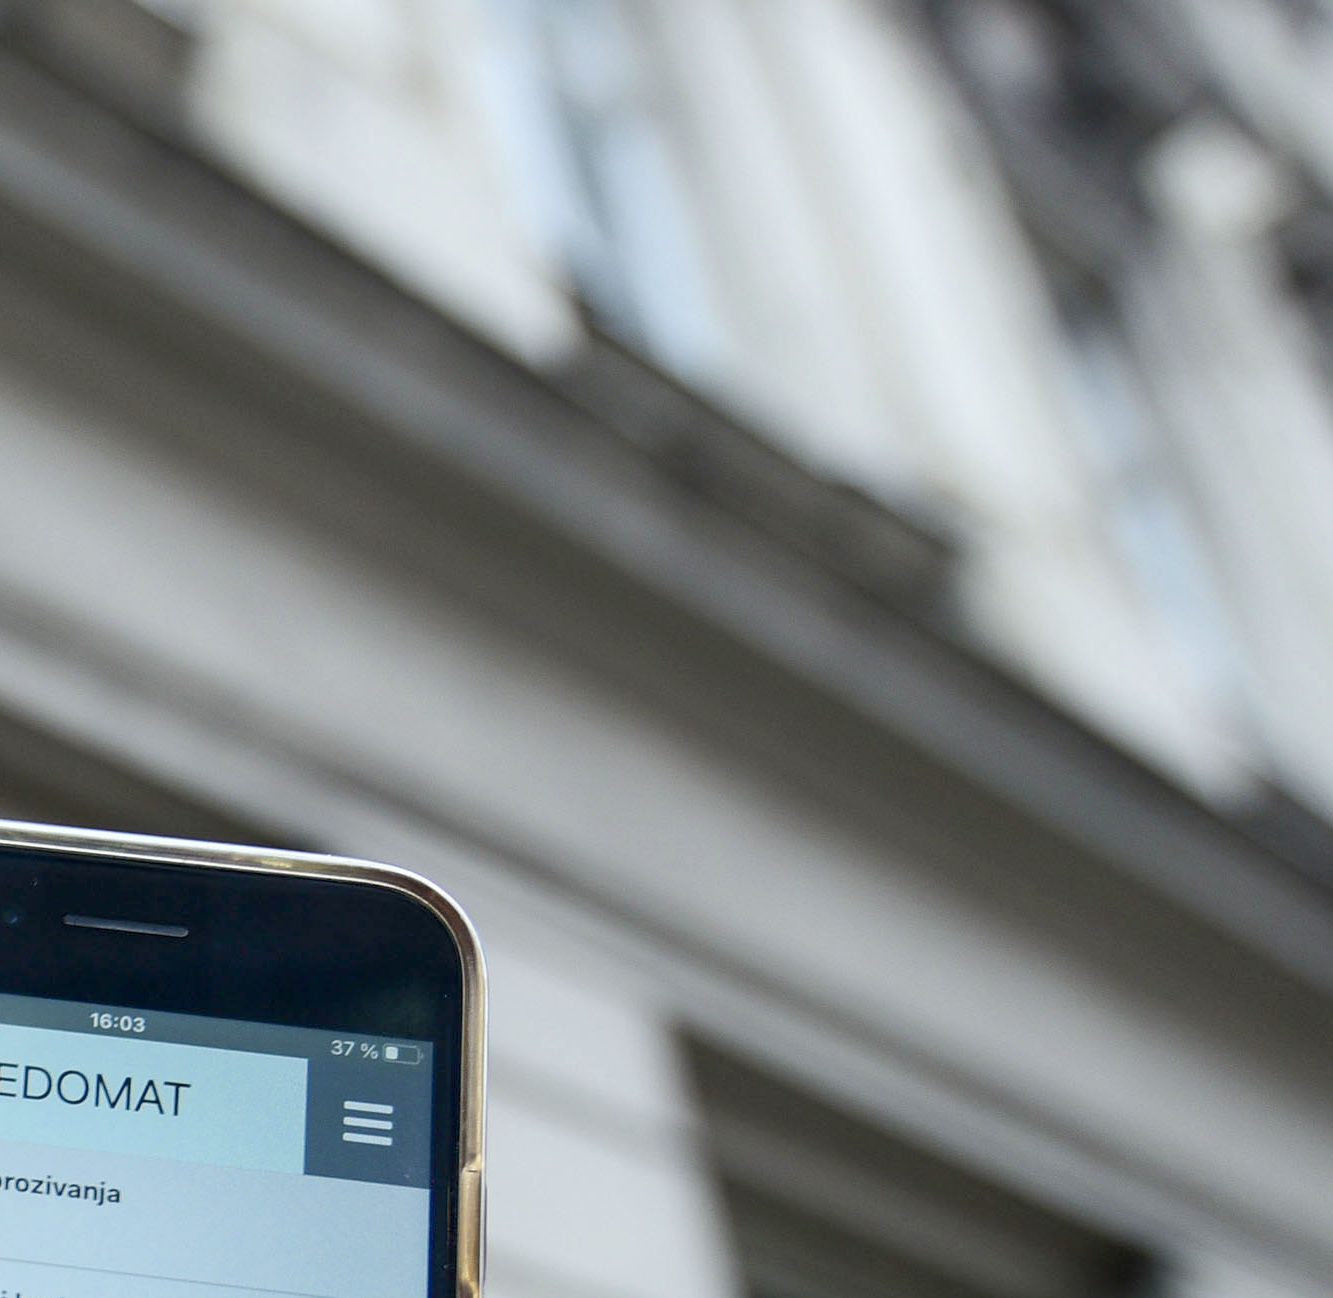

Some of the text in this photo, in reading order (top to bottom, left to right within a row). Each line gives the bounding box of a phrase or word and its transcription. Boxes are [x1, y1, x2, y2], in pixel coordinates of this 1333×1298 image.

[89, 1012, 146, 1033] 16:03
[330, 1039, 378, 1060] 37 %
